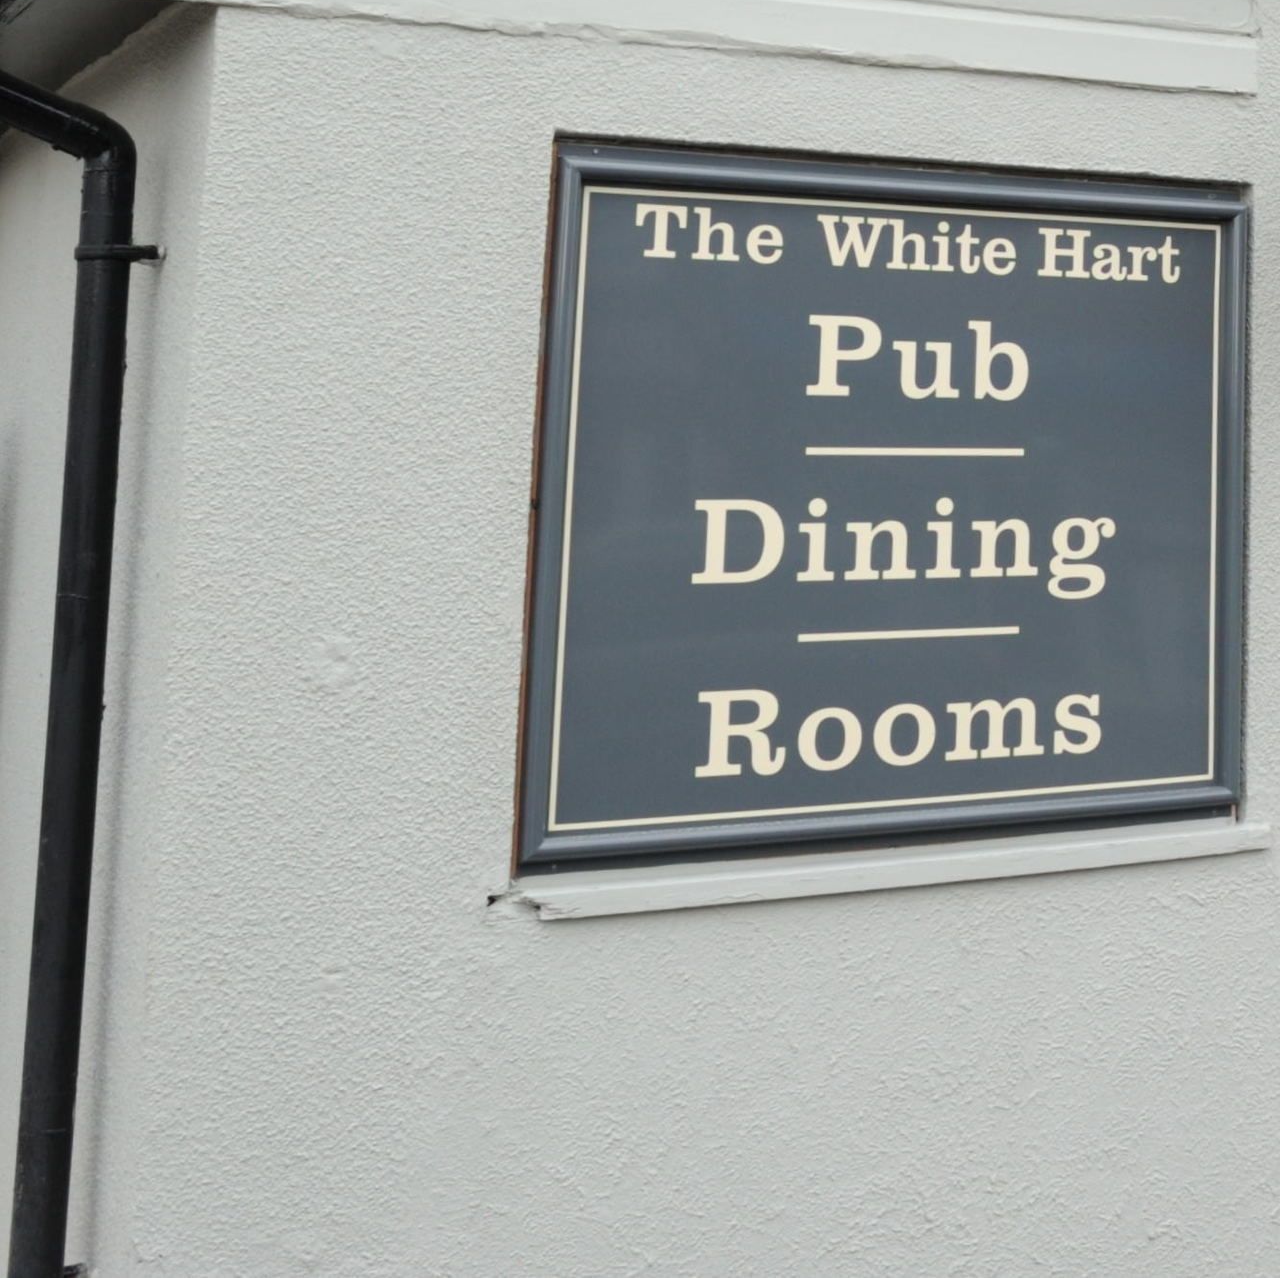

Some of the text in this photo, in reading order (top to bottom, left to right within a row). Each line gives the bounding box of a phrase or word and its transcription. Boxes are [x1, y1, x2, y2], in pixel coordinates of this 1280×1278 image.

[635, 203, 1181, 284] The White Hart
[805, 314, 1030, 401] Pub
[691, 497, 1116, 600] Dining
[694, 689, 1102, 778] Rooms
